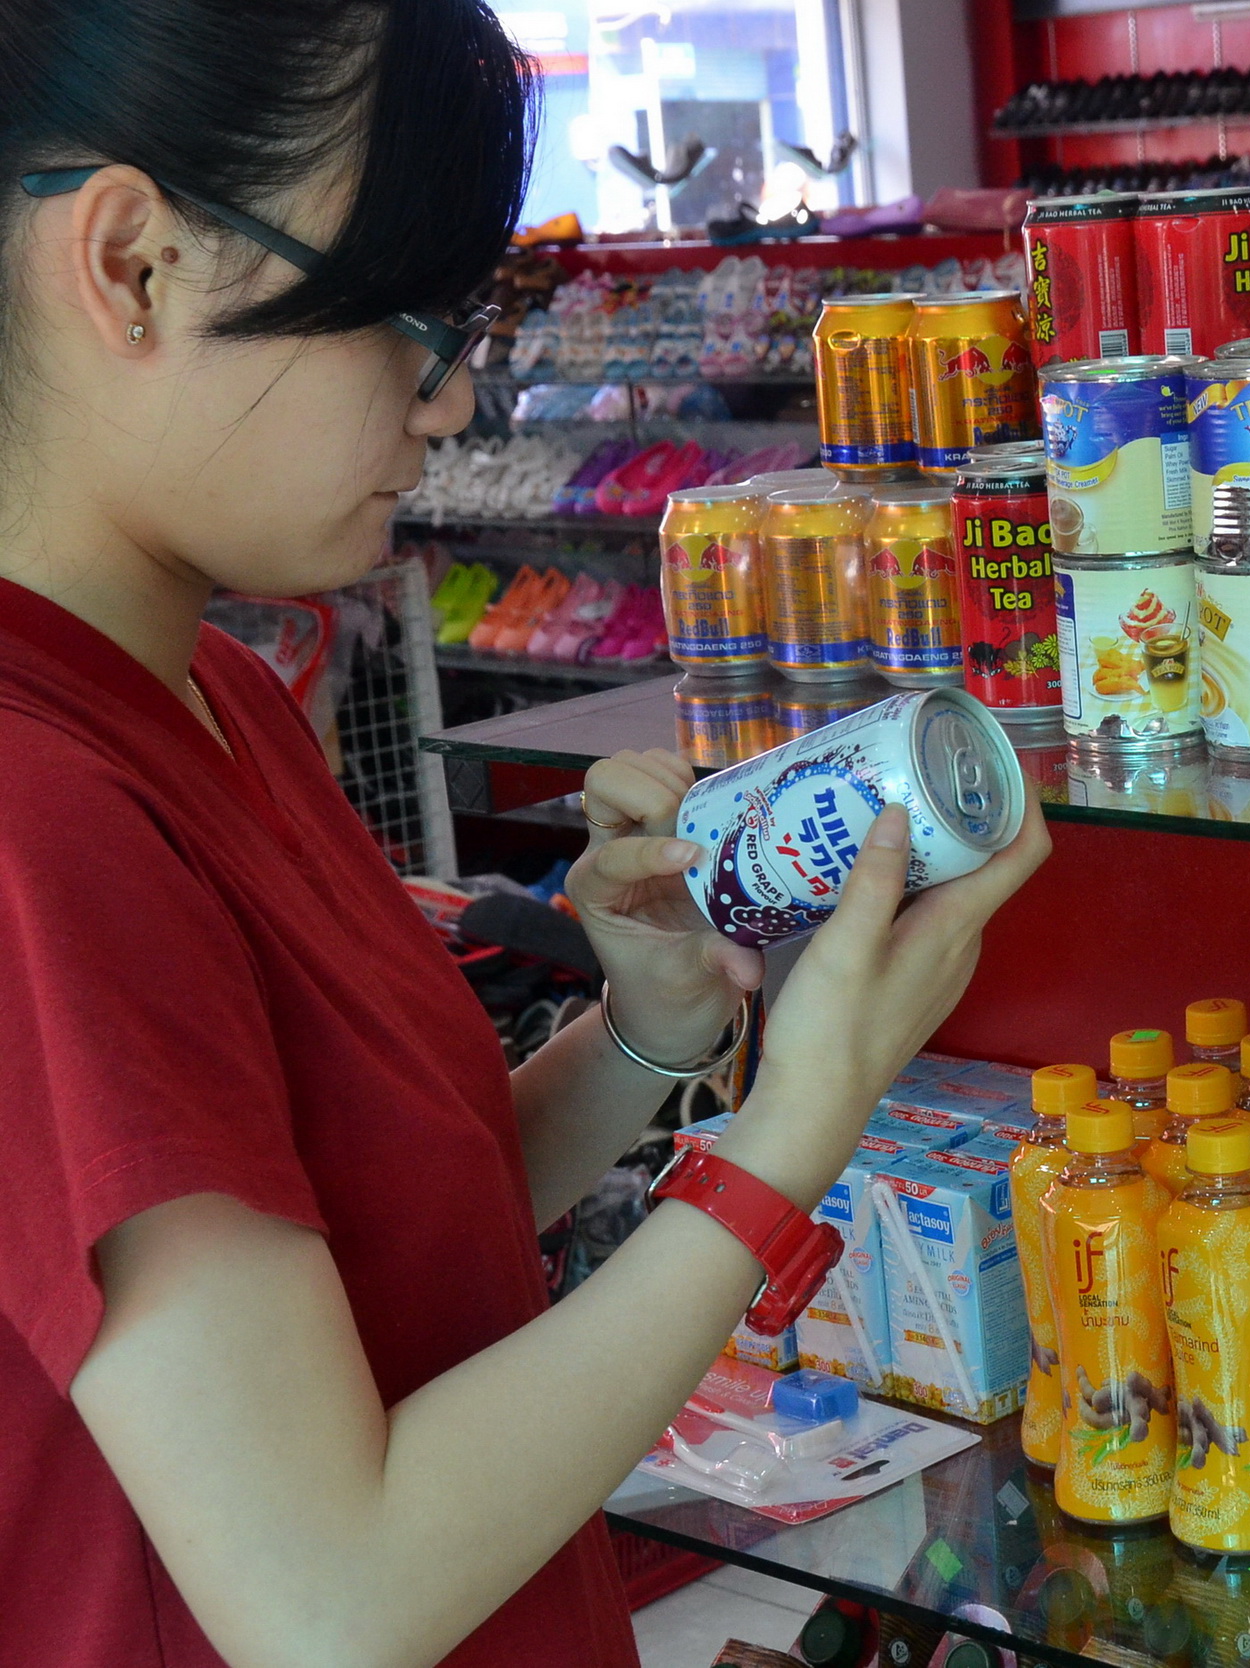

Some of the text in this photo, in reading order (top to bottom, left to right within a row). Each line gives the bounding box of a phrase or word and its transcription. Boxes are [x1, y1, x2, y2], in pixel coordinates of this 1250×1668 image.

[1224, 231, 1249, 262] Ji
[1015, 480, 1031, 488] TEA
[963, 518, 983, 548] Ji
[970, 555, 1052, 580] Herbal
[989, 587, 1033, 611] Tea
[740, 640, 762, 649] 250
[900, 782, 925, 826] CALPIS
[746, 833, 785, 902] RED GRAPE
[904, 1182, 920, 1196] 50
[926, 1245, 956, 1263] MILK
[1073, 1231, 1104, 1294] if
[1079, 1300, 1119, 1308] SENSATION
[816, 1361, 831, 1373] 300
[703, 1371, 751, 1394] smile
[913, 1382, 928, 1397] 300
